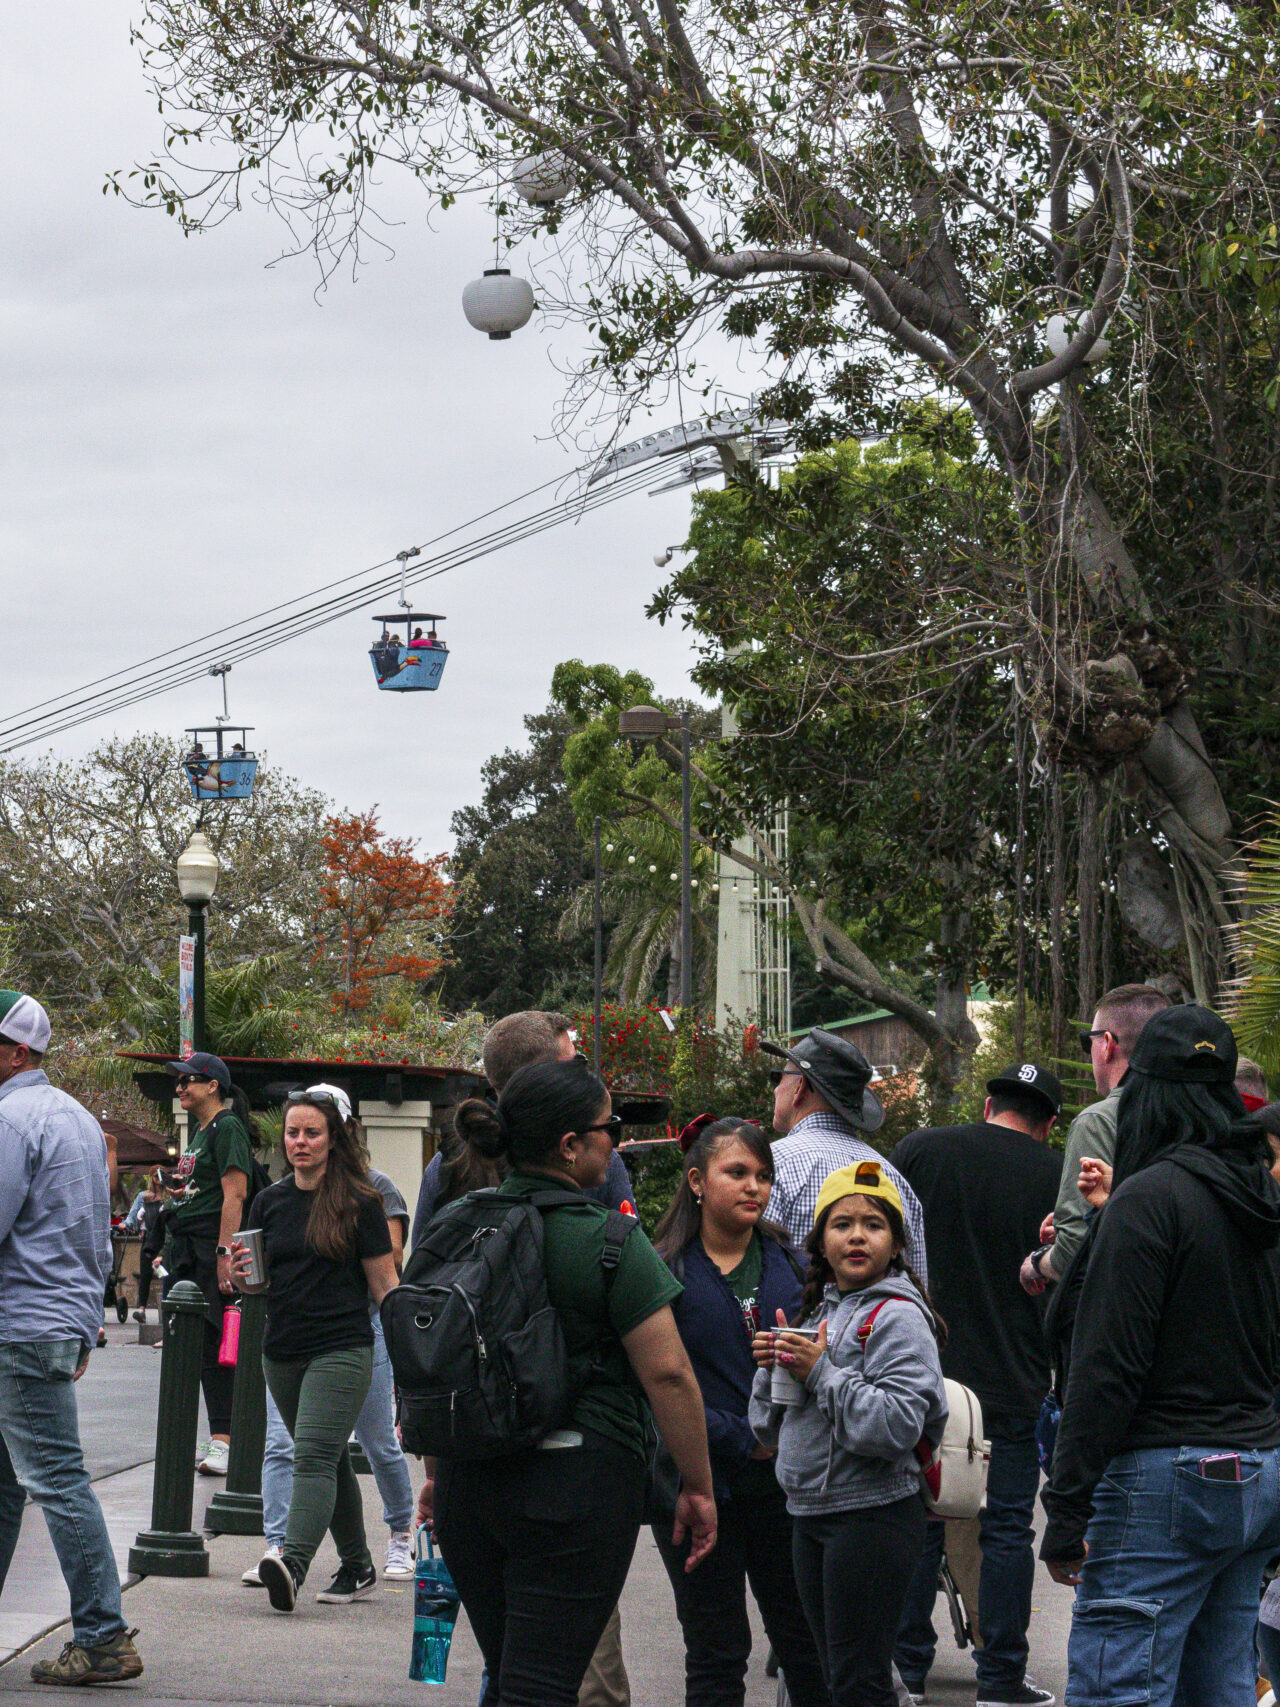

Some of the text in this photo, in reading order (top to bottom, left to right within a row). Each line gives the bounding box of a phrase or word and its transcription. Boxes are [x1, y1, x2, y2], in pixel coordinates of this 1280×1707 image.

[429, 662, 442, 677] 27
[239, 771, 251, 786] 36
[1018, 1064, 1038, 1083] SD
